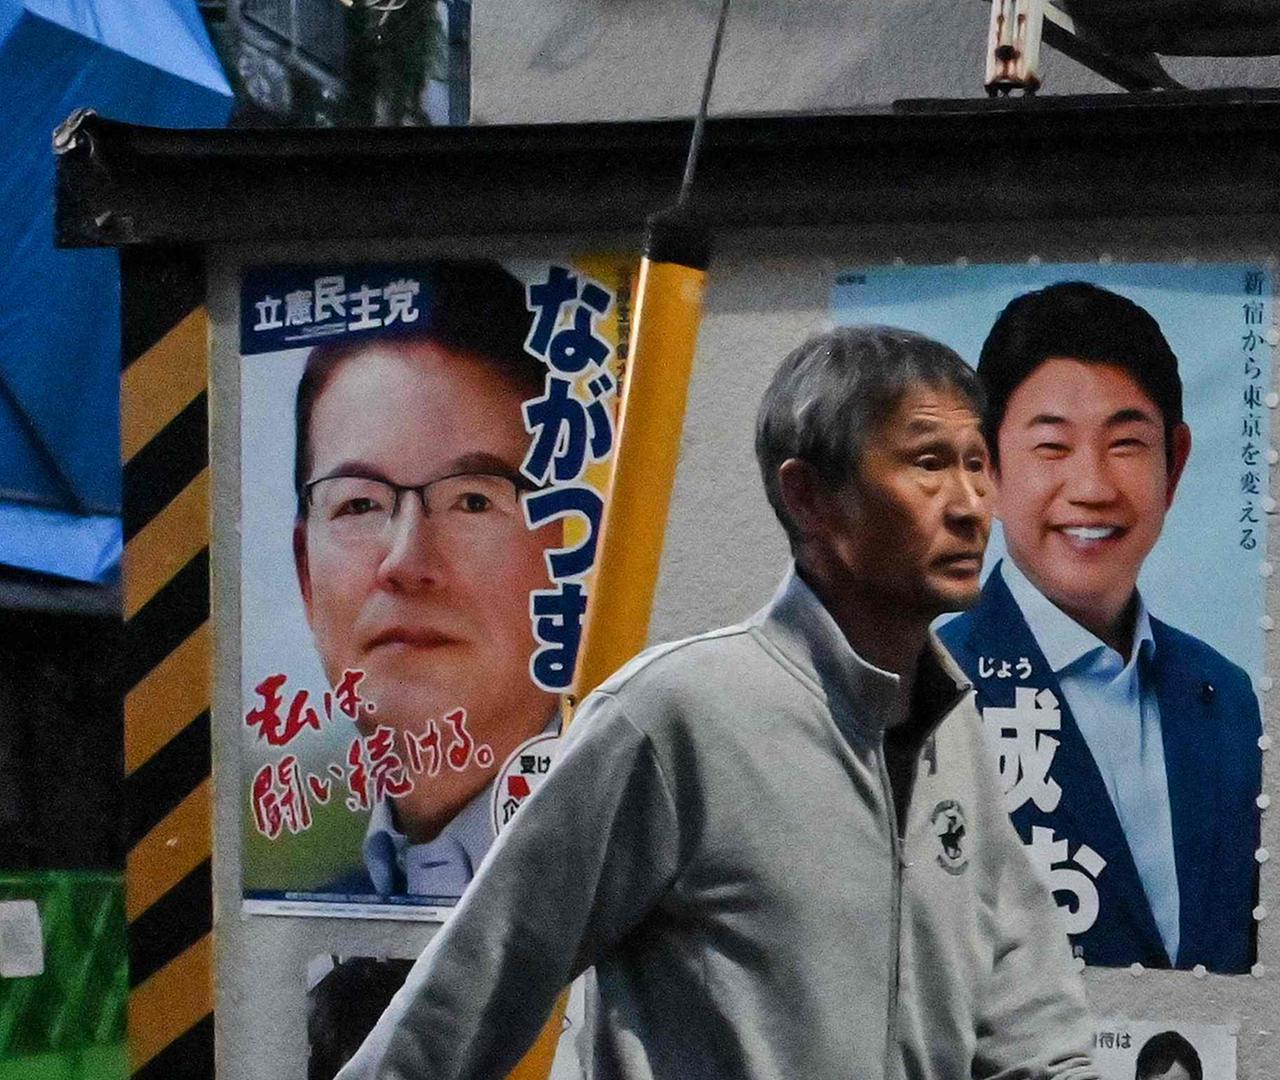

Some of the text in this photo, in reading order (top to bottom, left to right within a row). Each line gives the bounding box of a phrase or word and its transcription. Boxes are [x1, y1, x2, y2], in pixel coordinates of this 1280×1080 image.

[254, 275, 420, 331] 立憲民主党
[1239, 270, 1264, 551] 新宿から東京を変える
[520, 265, 615, 693] ながつま
[978, 656, 1033, 680] じょう
[251, 707, 493, 840] 闘い続ける。
